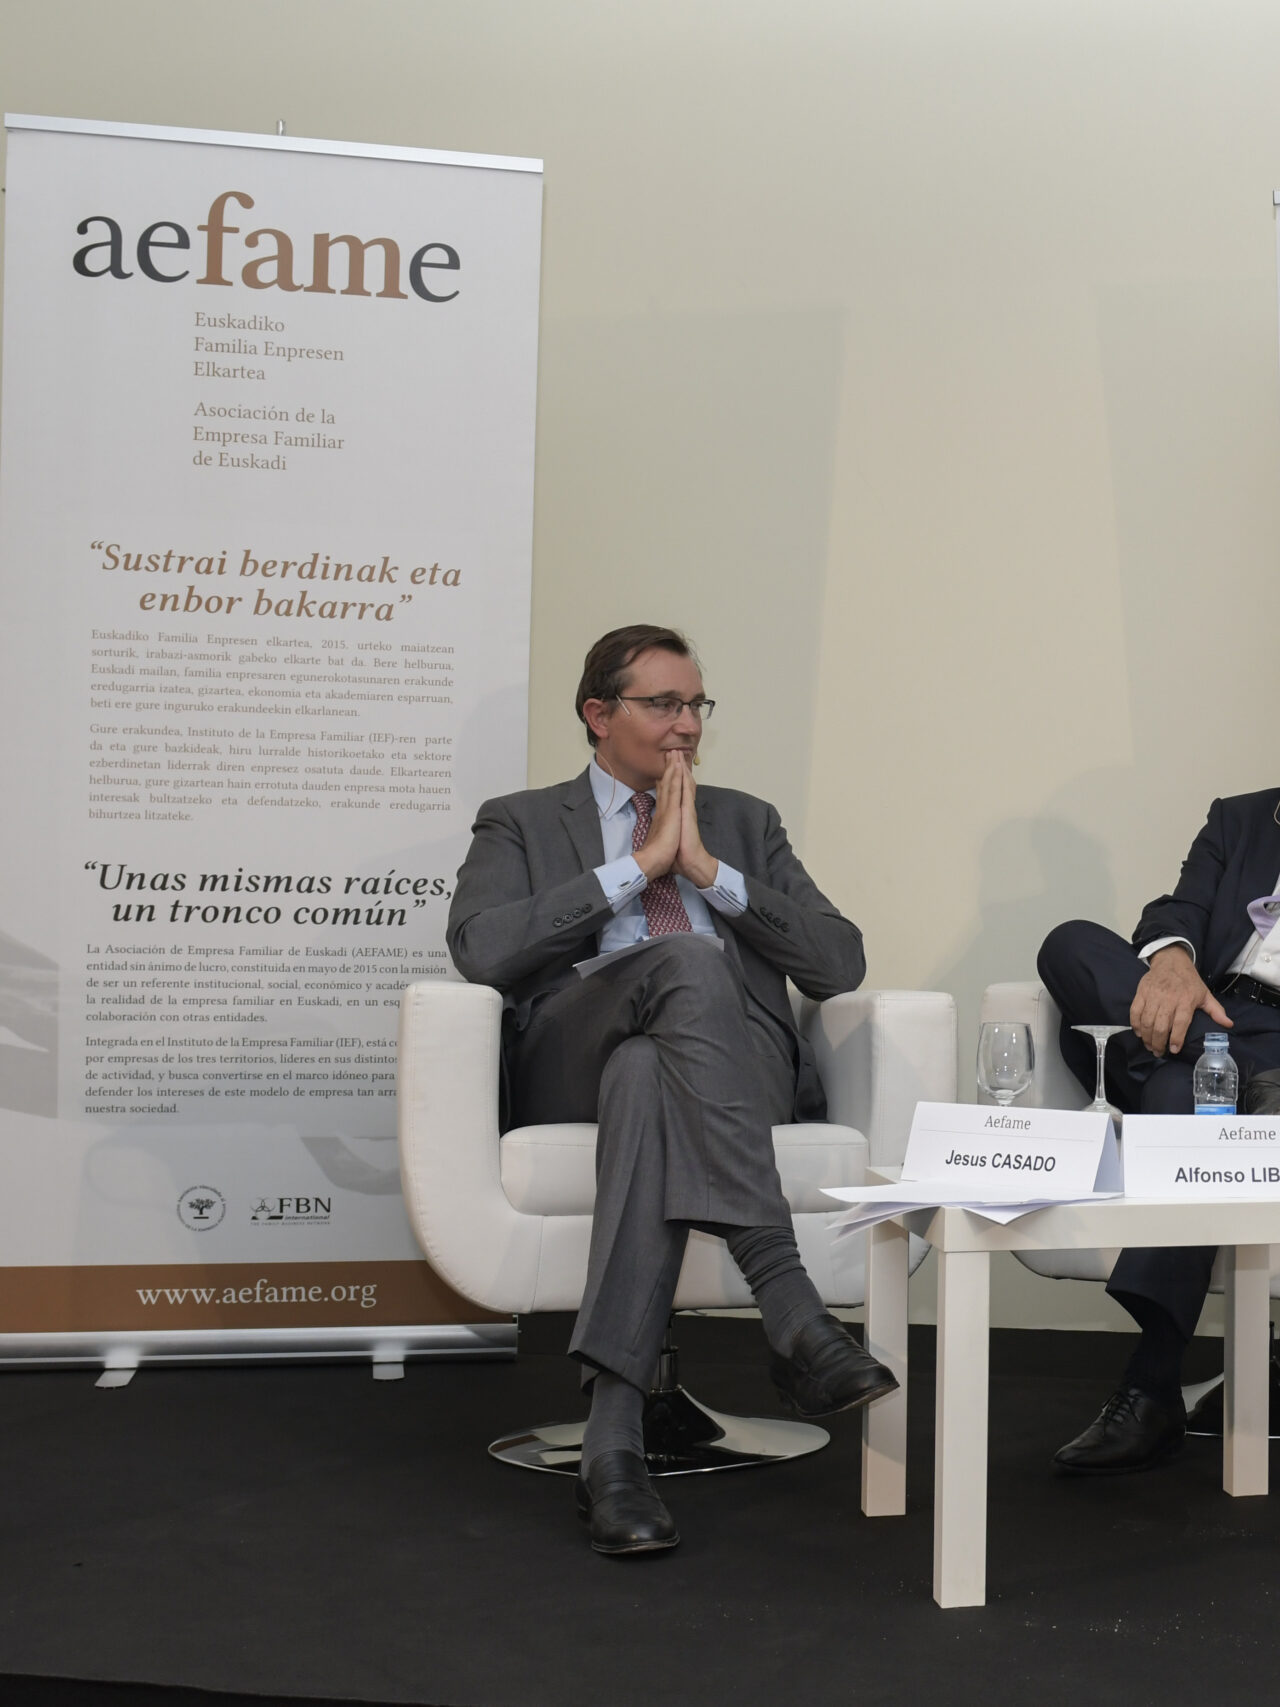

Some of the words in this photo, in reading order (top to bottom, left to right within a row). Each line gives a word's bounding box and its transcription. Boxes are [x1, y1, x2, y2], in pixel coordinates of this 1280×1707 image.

[72, 192, 460, 303] aefame
[194, 311, 285, 332] Euskadiko
[194, 336, 258, 355] Familia
[263, 340, 344, 362] Enpresen
[193, 361, 265, 380] Elkartea
[193, 401, 289, 421] Asociación
[295, 407, 315, 423] de
[320, 408, 335, 424] la
[192, 427, 268, 447] Empresa
[273, 430, 345, 449] Familiar
[192, 451, 213, 466] de
[217, 452, 286, 470] Euskadi
[89, 540, 227, 576] “Sustrai
[238, 548, 399, 584] berdinak
[409, 562, 461, 587] eta
[138, 584, 243, 614] enbor
[252, 587, 412, 621] bakarra”
[84, 860, 186, 891] “Unas
[198, 867, 332, 894] mismas
[343, 868, 454, 904] raíces,
[112, 903, 155, 922] un
[169, 899, 281, 924] tronco
[292, 898, 426, 926] común”
[85, 1010, 156, 1022] colaboración
[159, 1014, 180, 1022] con
[182, 1013, 210, 1022] otras
[212, 1011, 268, 1023] entidades.
[84, 1104, 126, 1113] nuestra
[129, 1103, 179, 1114] sociedad.
[983, 1114, 1031, 1130] Aefame
[1217, 1126, 1276, 1140] Aefame
[945, 1149, 987, 1167] Jesus
[991, 1152, 1056, 1172] CASADO
[1174, 1166, 1245, 1183] Alfonso
[278, 1197, 331, 1213] FBN
[135, 1278, 377, 1308] www.aefame.org
